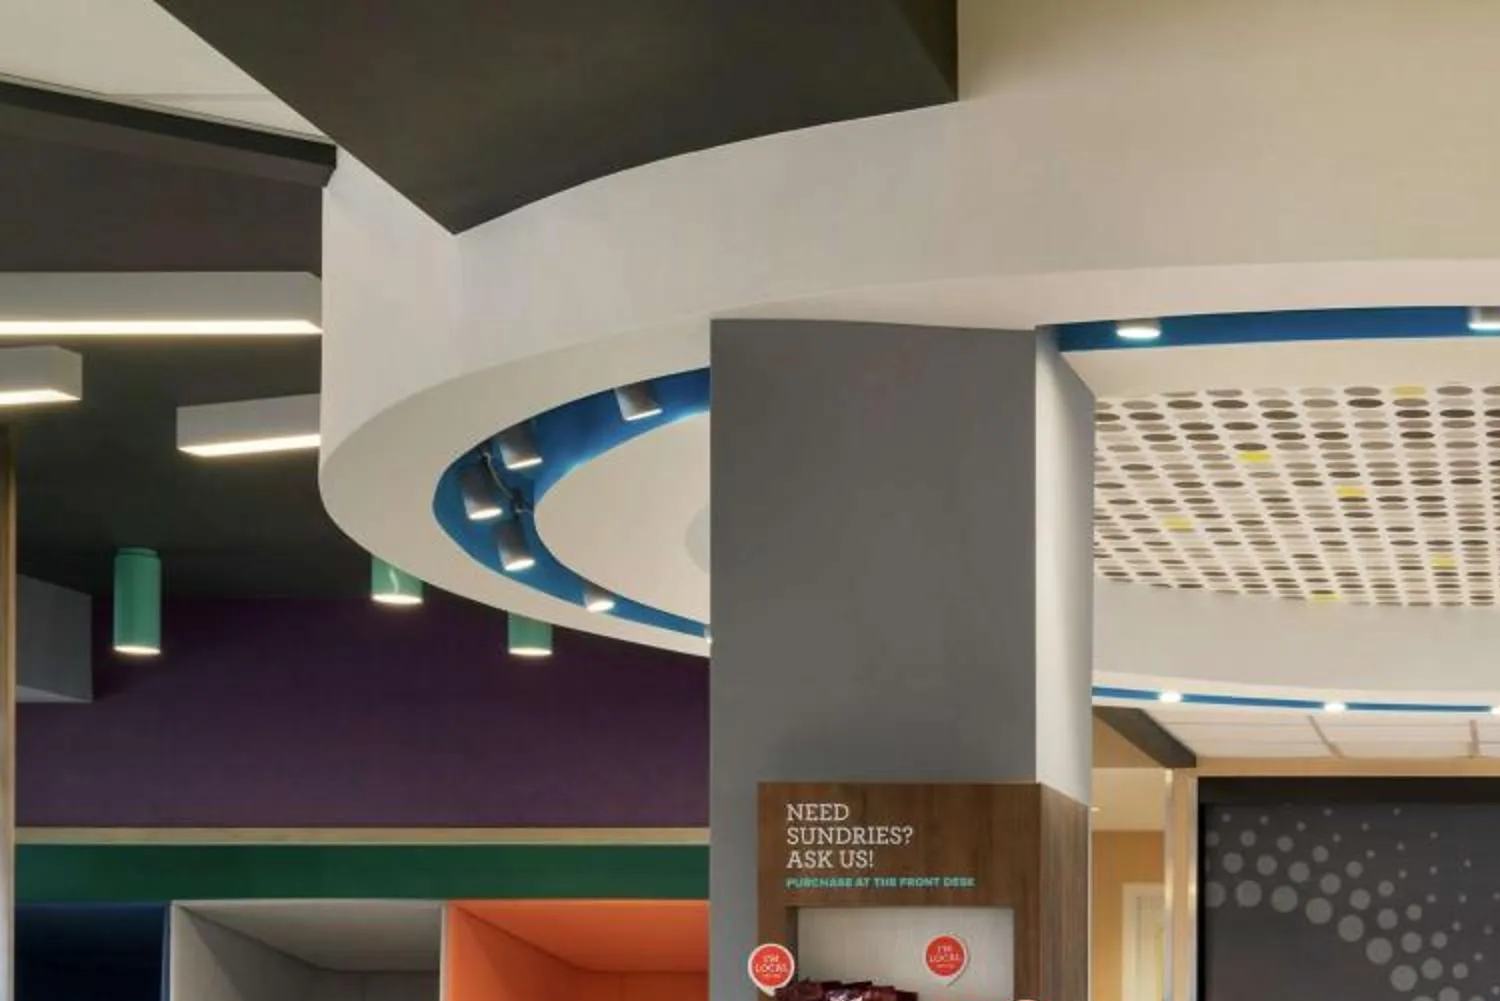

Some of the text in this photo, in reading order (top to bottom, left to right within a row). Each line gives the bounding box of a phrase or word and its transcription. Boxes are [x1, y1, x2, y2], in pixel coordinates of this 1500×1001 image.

[786, 803, 850, 821] NEED
[786, 826, 914, 845] SUNDRIES?
[786, 850, 874, 869] ASK US!
[786, 877, 976, 889] PURCHASE AT THE FRONT DESK
[928, 952, 961, 962] LOCAL
[755, 963, 789, 974] LOCAL
